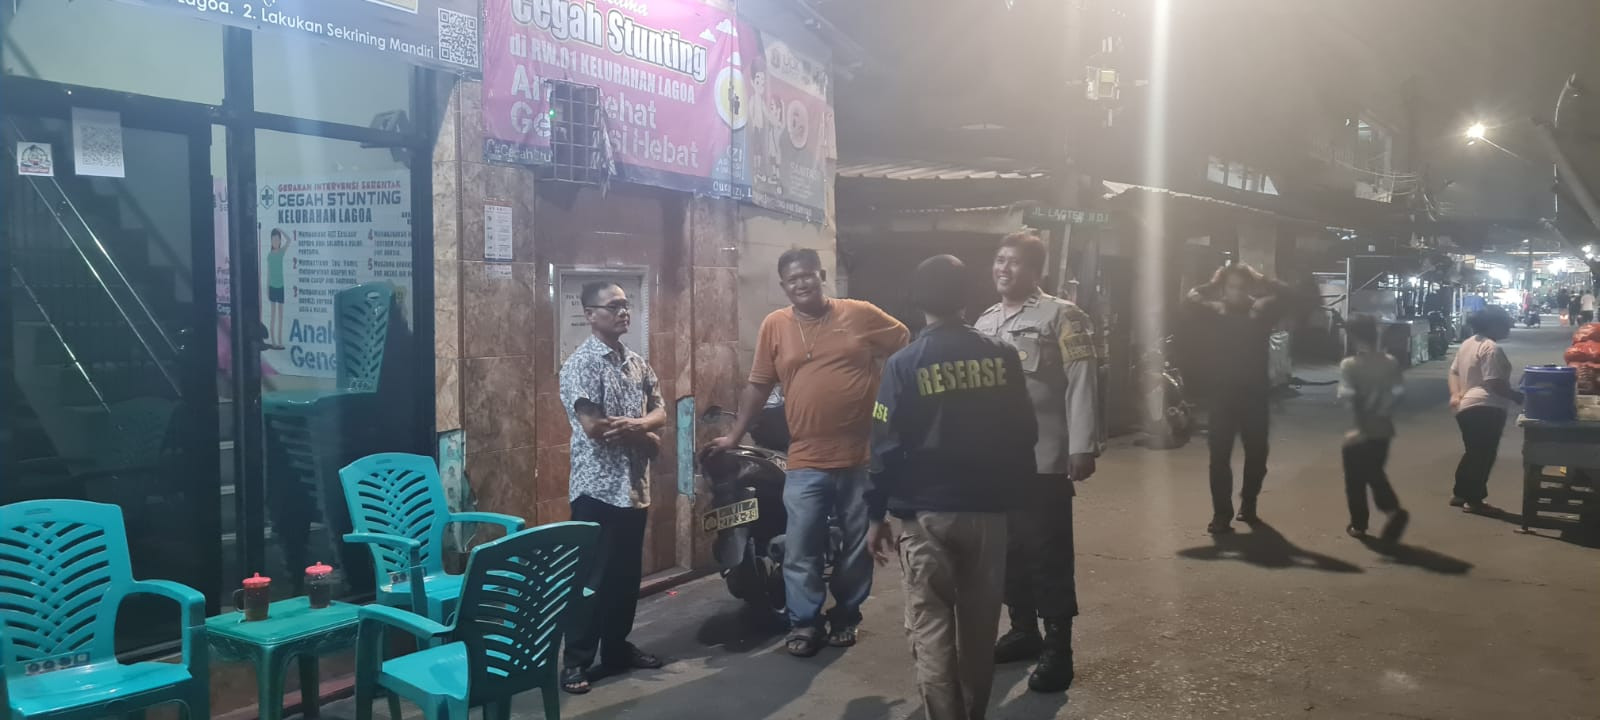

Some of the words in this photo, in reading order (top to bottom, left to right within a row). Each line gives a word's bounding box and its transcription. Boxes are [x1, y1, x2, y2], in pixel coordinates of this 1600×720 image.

[178, 0, 234, 14] agoa.
[243, 4, 256, 19] 2.
[261, 8, 323, 34] Lakukan
[327, 22, 386, 51] Sekrining
[389, 37, 434, 59] Mandiri
[606, 8, 707, 84] Stunting
[510, 33, 527, 58] di
[580, 53, 656, 94] KELURAHAN
[658, 75, 695, 105] LAGOA
[603, 91, 656, 129] ehat
[633, 128, 699, 169] Hebat
[278, 193, 323, 207] CEGAH
[327, 190, 401, 206] STUNTING
[339, 207, 372, 223] LAGOA
[917, 357, 1007, 396] RESERSE
